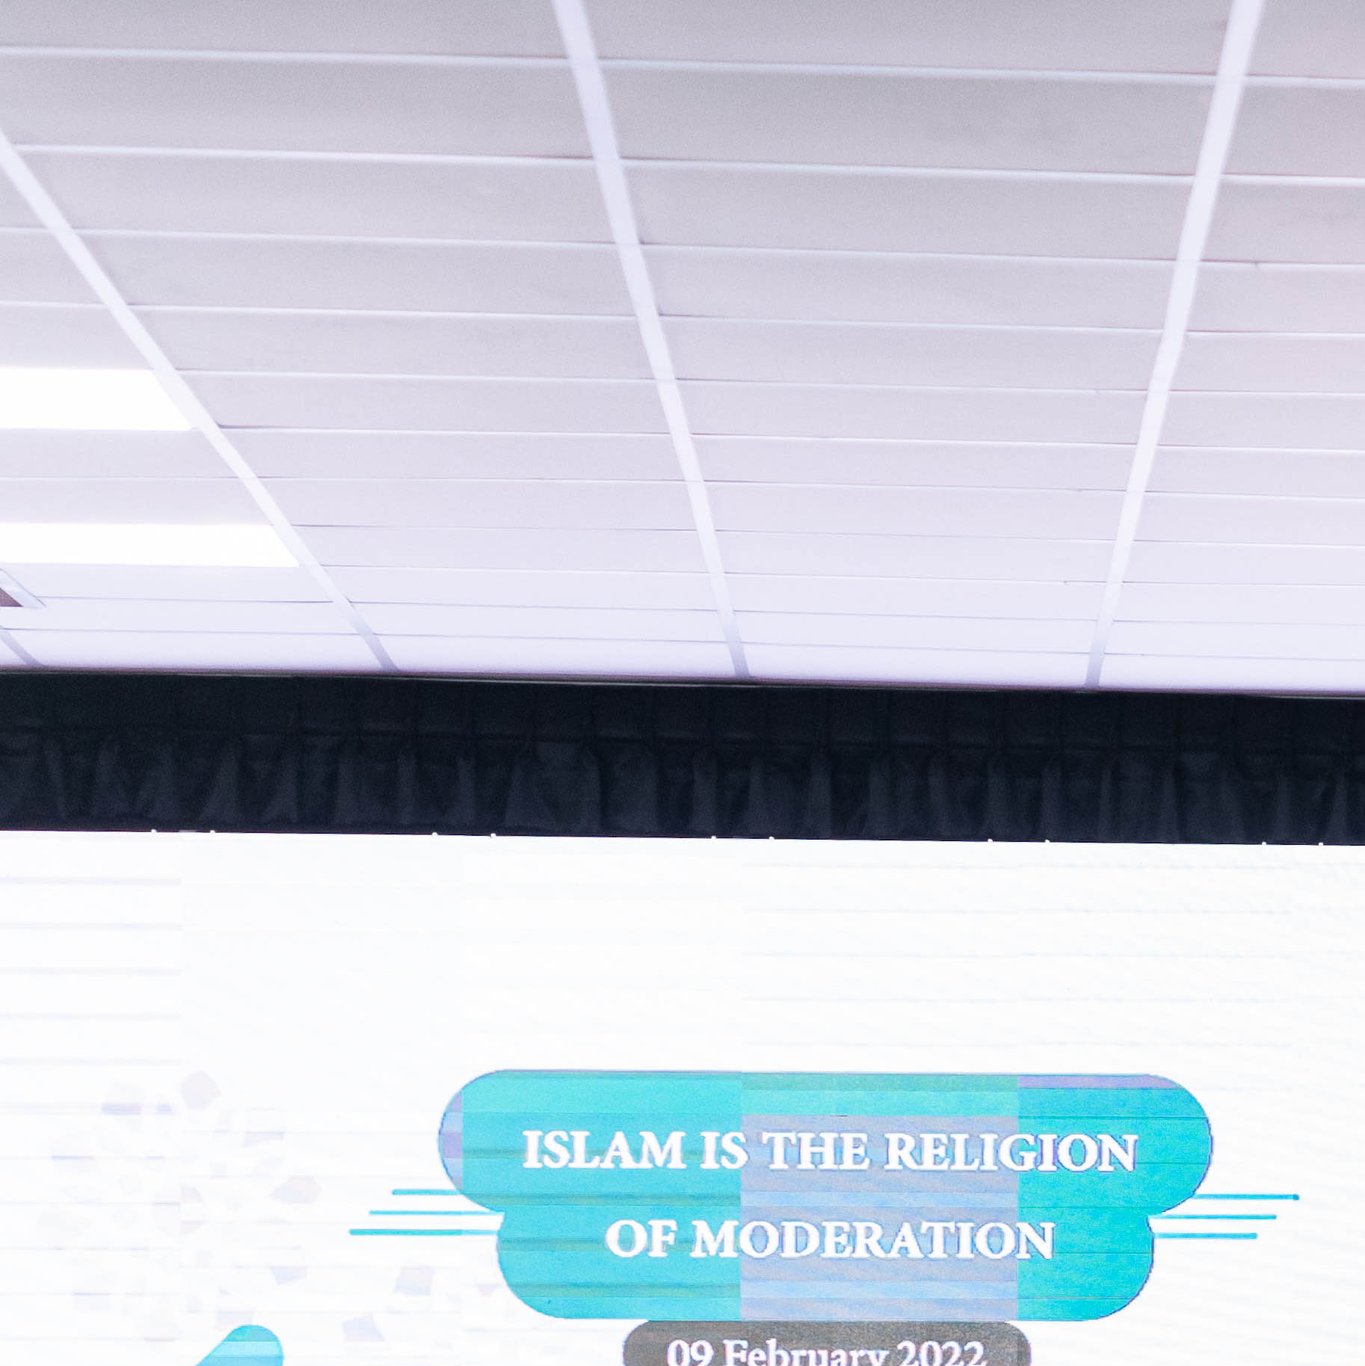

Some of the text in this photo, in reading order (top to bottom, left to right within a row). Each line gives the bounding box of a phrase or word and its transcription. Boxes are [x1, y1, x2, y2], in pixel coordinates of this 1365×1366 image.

[522, 1129, 1139, 1172] ISLAM IS THE RELIGION
[605, 1219, 1056, 1260] OF MODERATION
